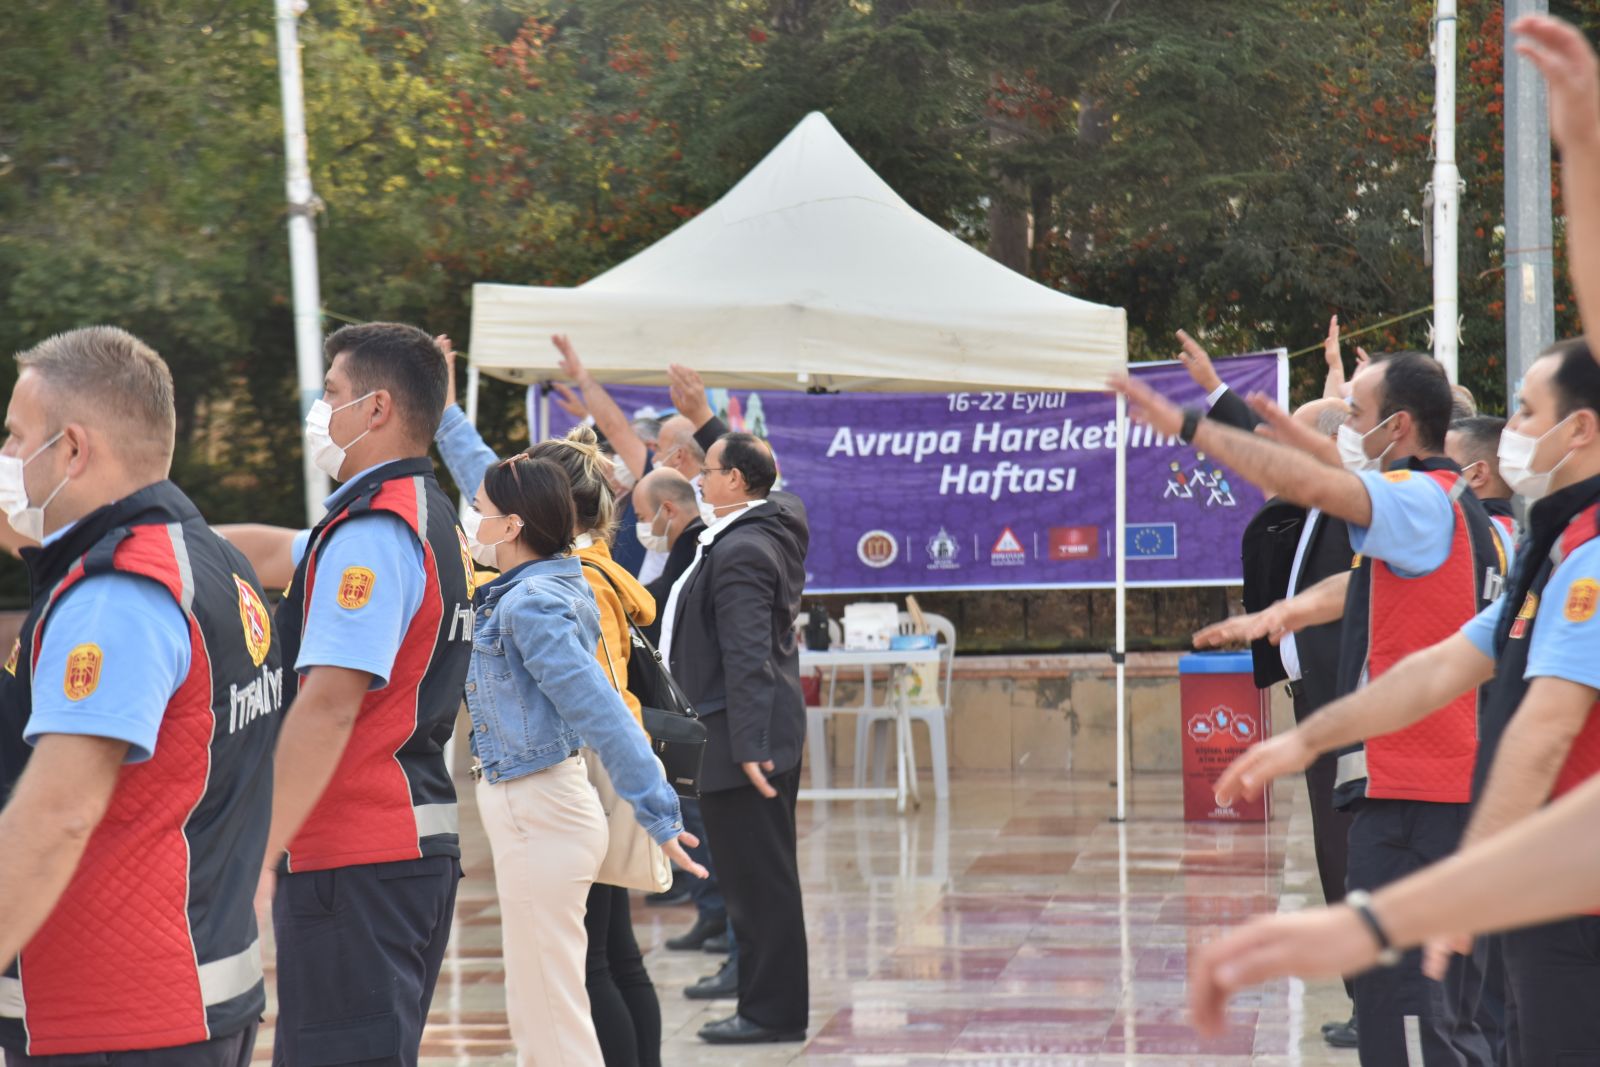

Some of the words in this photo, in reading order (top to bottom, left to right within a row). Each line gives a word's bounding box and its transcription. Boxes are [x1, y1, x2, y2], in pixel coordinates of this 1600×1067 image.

[946, 391, 1006, 412] 16-22
[826, 427, 961, 463] Avrupa
[939, 462, 1076, 500] Haftası
